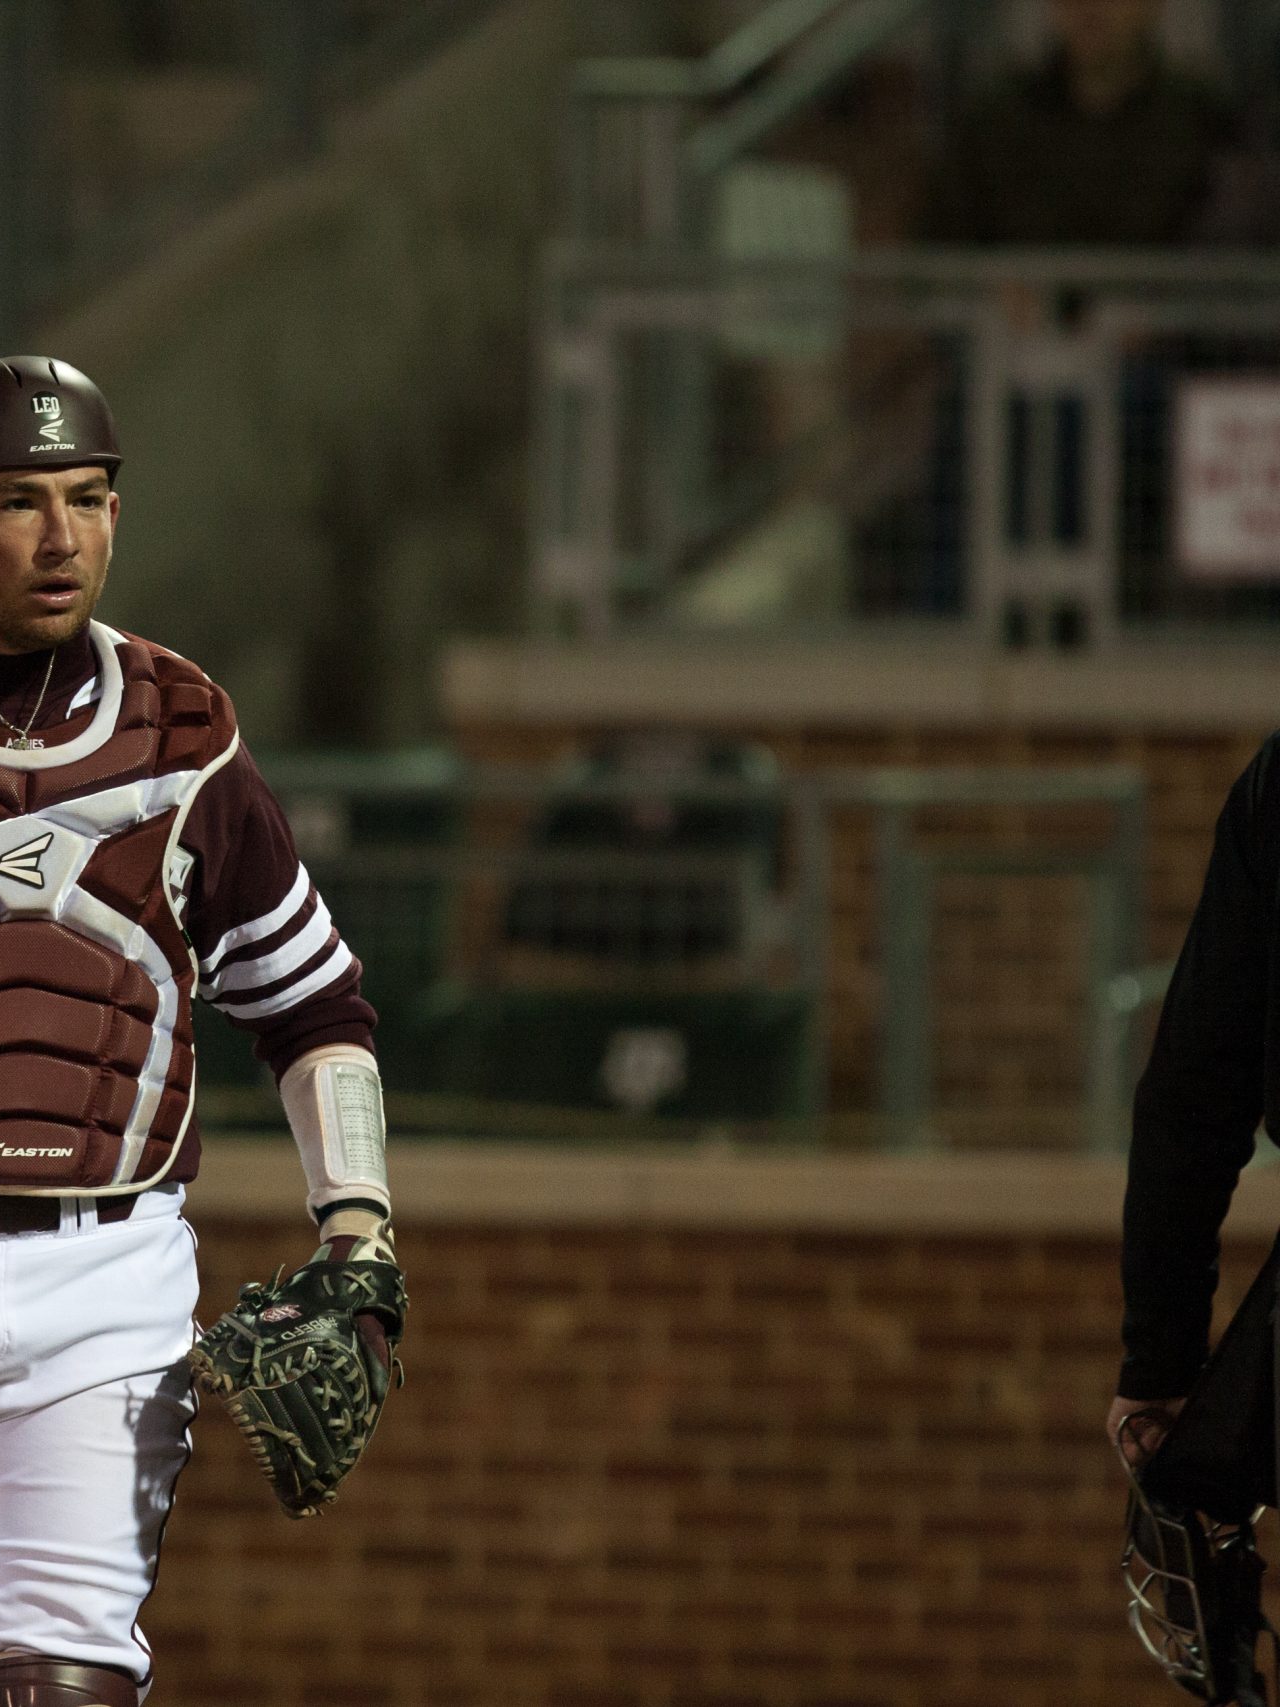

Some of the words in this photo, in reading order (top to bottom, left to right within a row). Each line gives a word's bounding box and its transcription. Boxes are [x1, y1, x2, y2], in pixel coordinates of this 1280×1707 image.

[32, 396, 61, 413] LEO
[29, 444, 76, 453] EASTON
[6, 737, 45, 750] AIES
[1, 1148, 73, 1157] EASTON
